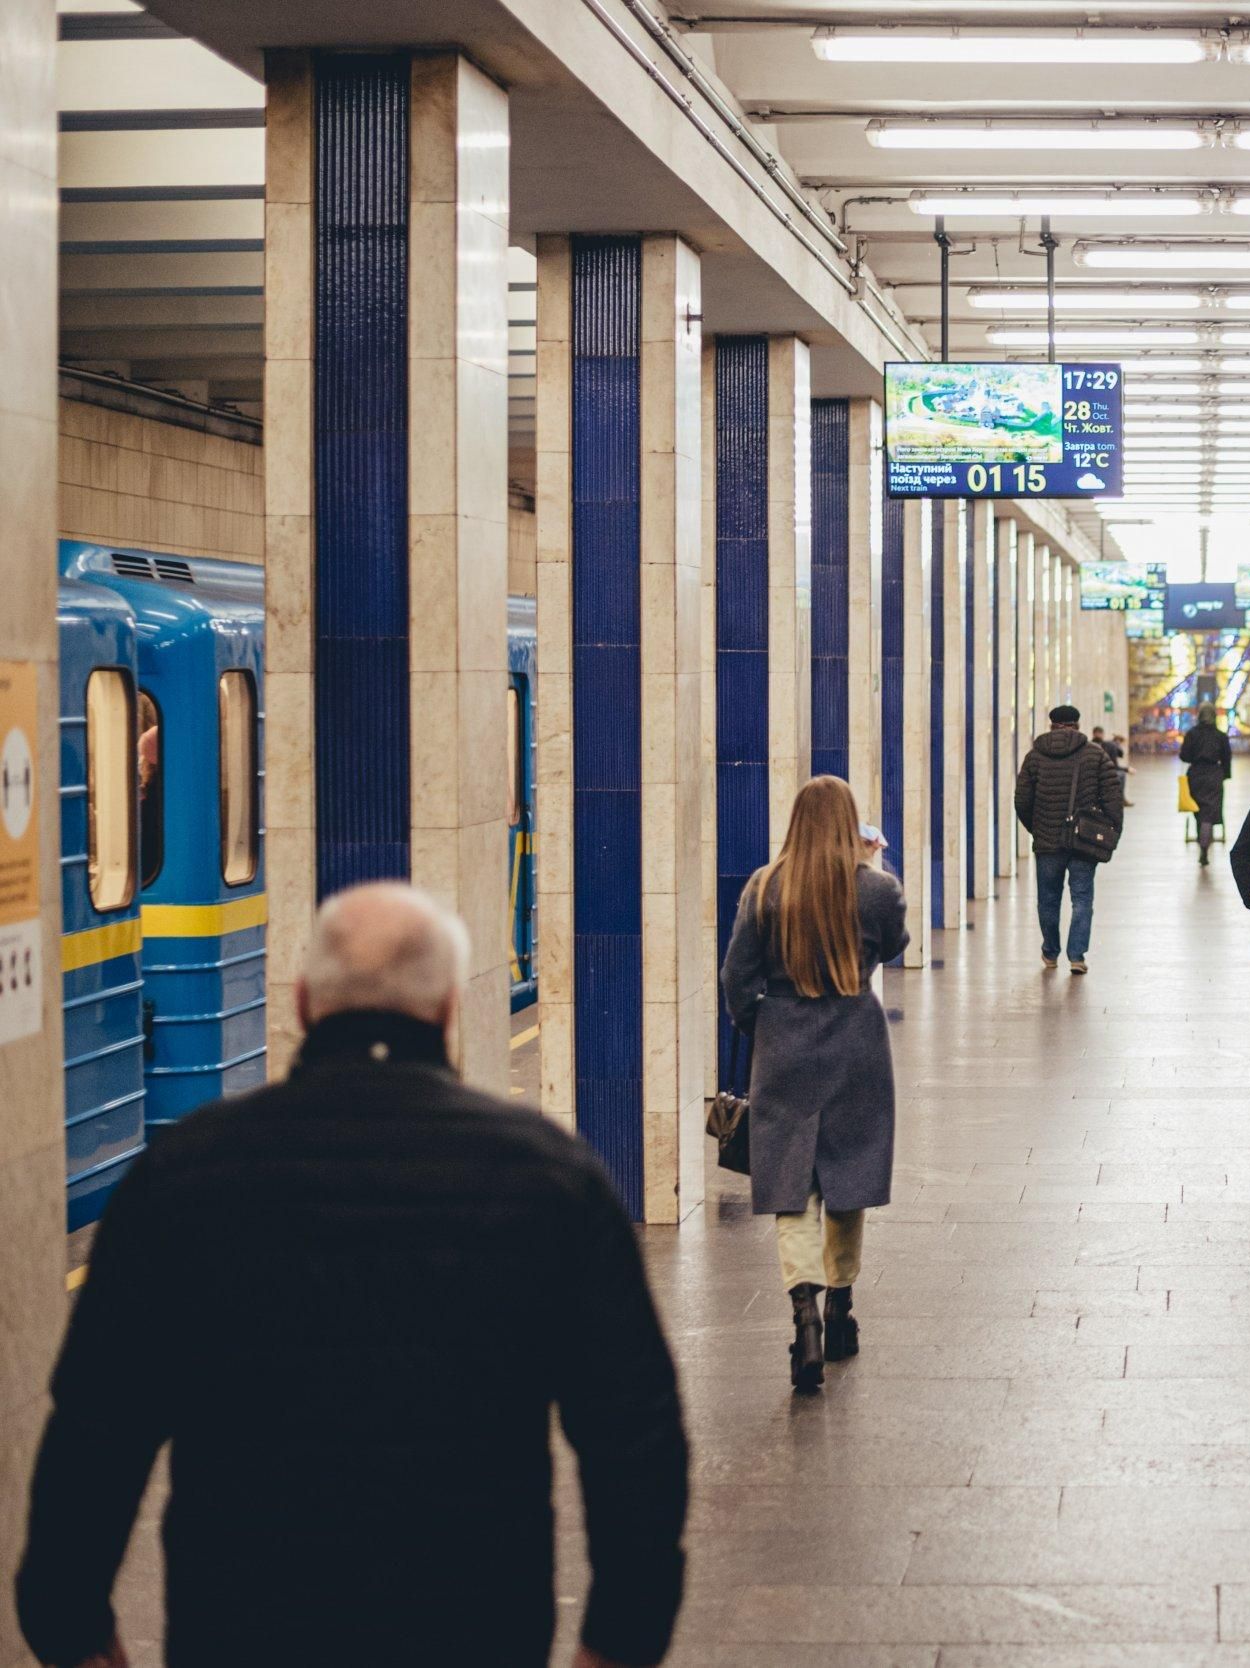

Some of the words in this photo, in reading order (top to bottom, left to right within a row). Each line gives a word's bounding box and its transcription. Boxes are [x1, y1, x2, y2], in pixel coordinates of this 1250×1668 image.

[1063, 371, 1118, 390] 17:29
[1063, 400, 1091, 421] 28
[1093, 402, 1109, 410] Thu.
[1092, 412, 1109, 420] Oct.
[1063, 423, 1080, 433] Чт.
[1081, 422, 1114, 433] Жовт.
[1064, 441, 1096, 452] Завтра
[1073, 453, 1110, 468] 12°C
[890, 463, 952, 476] Наступний
[890, 474, 922, 486] поїзд
[923, 475, 957, 486] через
[967, 464, 1002, 493] 01
[1012, 464, 1047, 493] 15
[890, 484, 909, 492] Next
[910, 484, 928, 492] train
